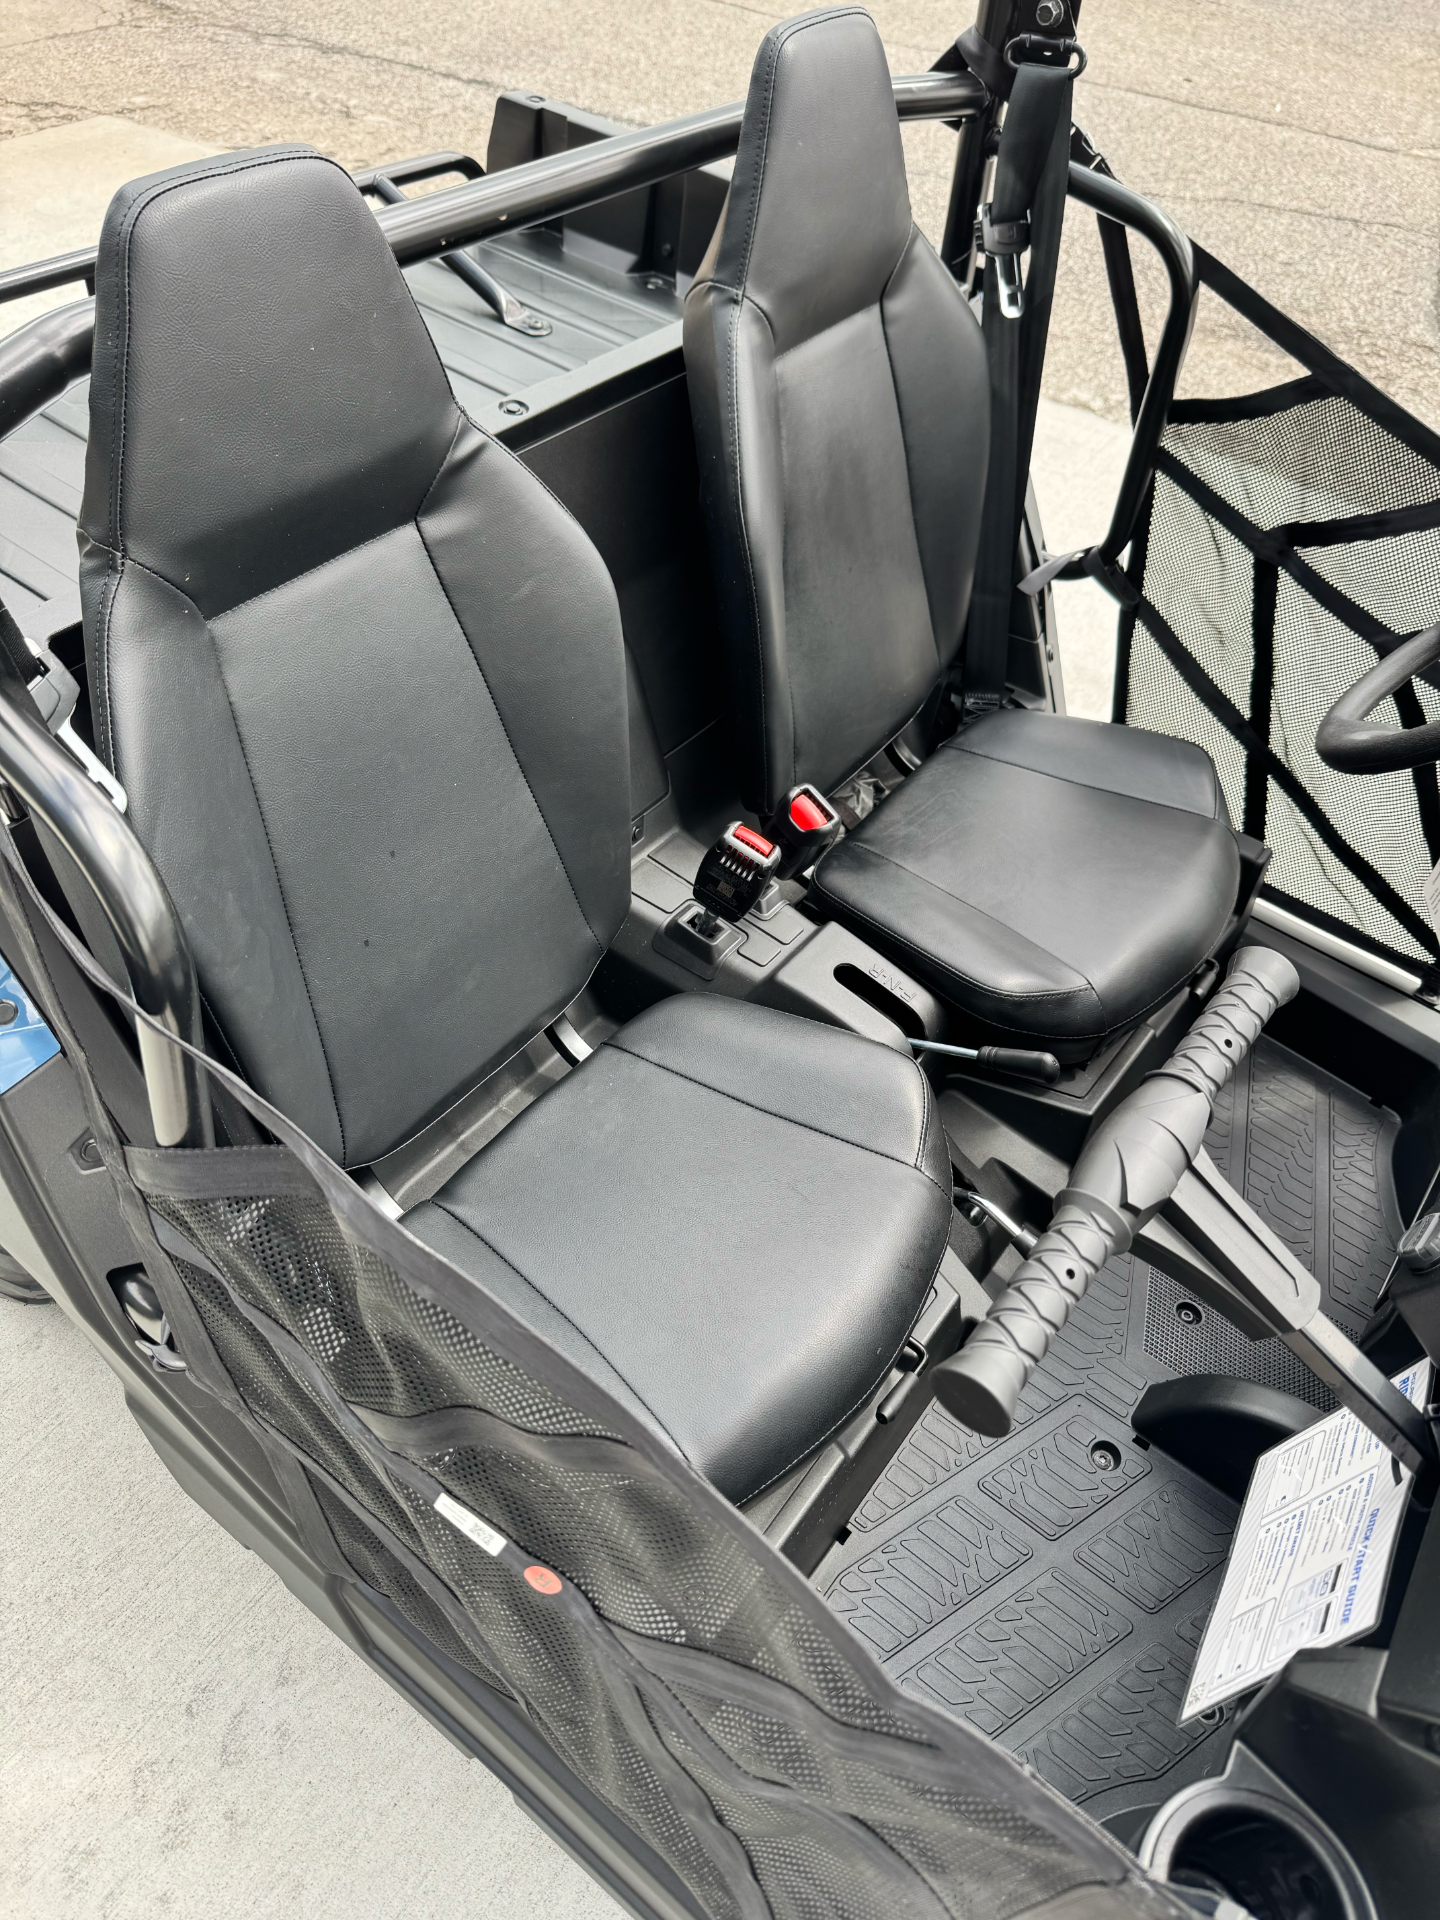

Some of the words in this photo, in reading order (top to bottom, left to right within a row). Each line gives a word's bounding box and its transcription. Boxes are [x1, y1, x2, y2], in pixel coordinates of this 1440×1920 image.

[1361, 1508, 1380, 1543] QUICK
[533, 1573, 553, 1588] R
[1340, 1585, 1357, 1625] GUIDE
